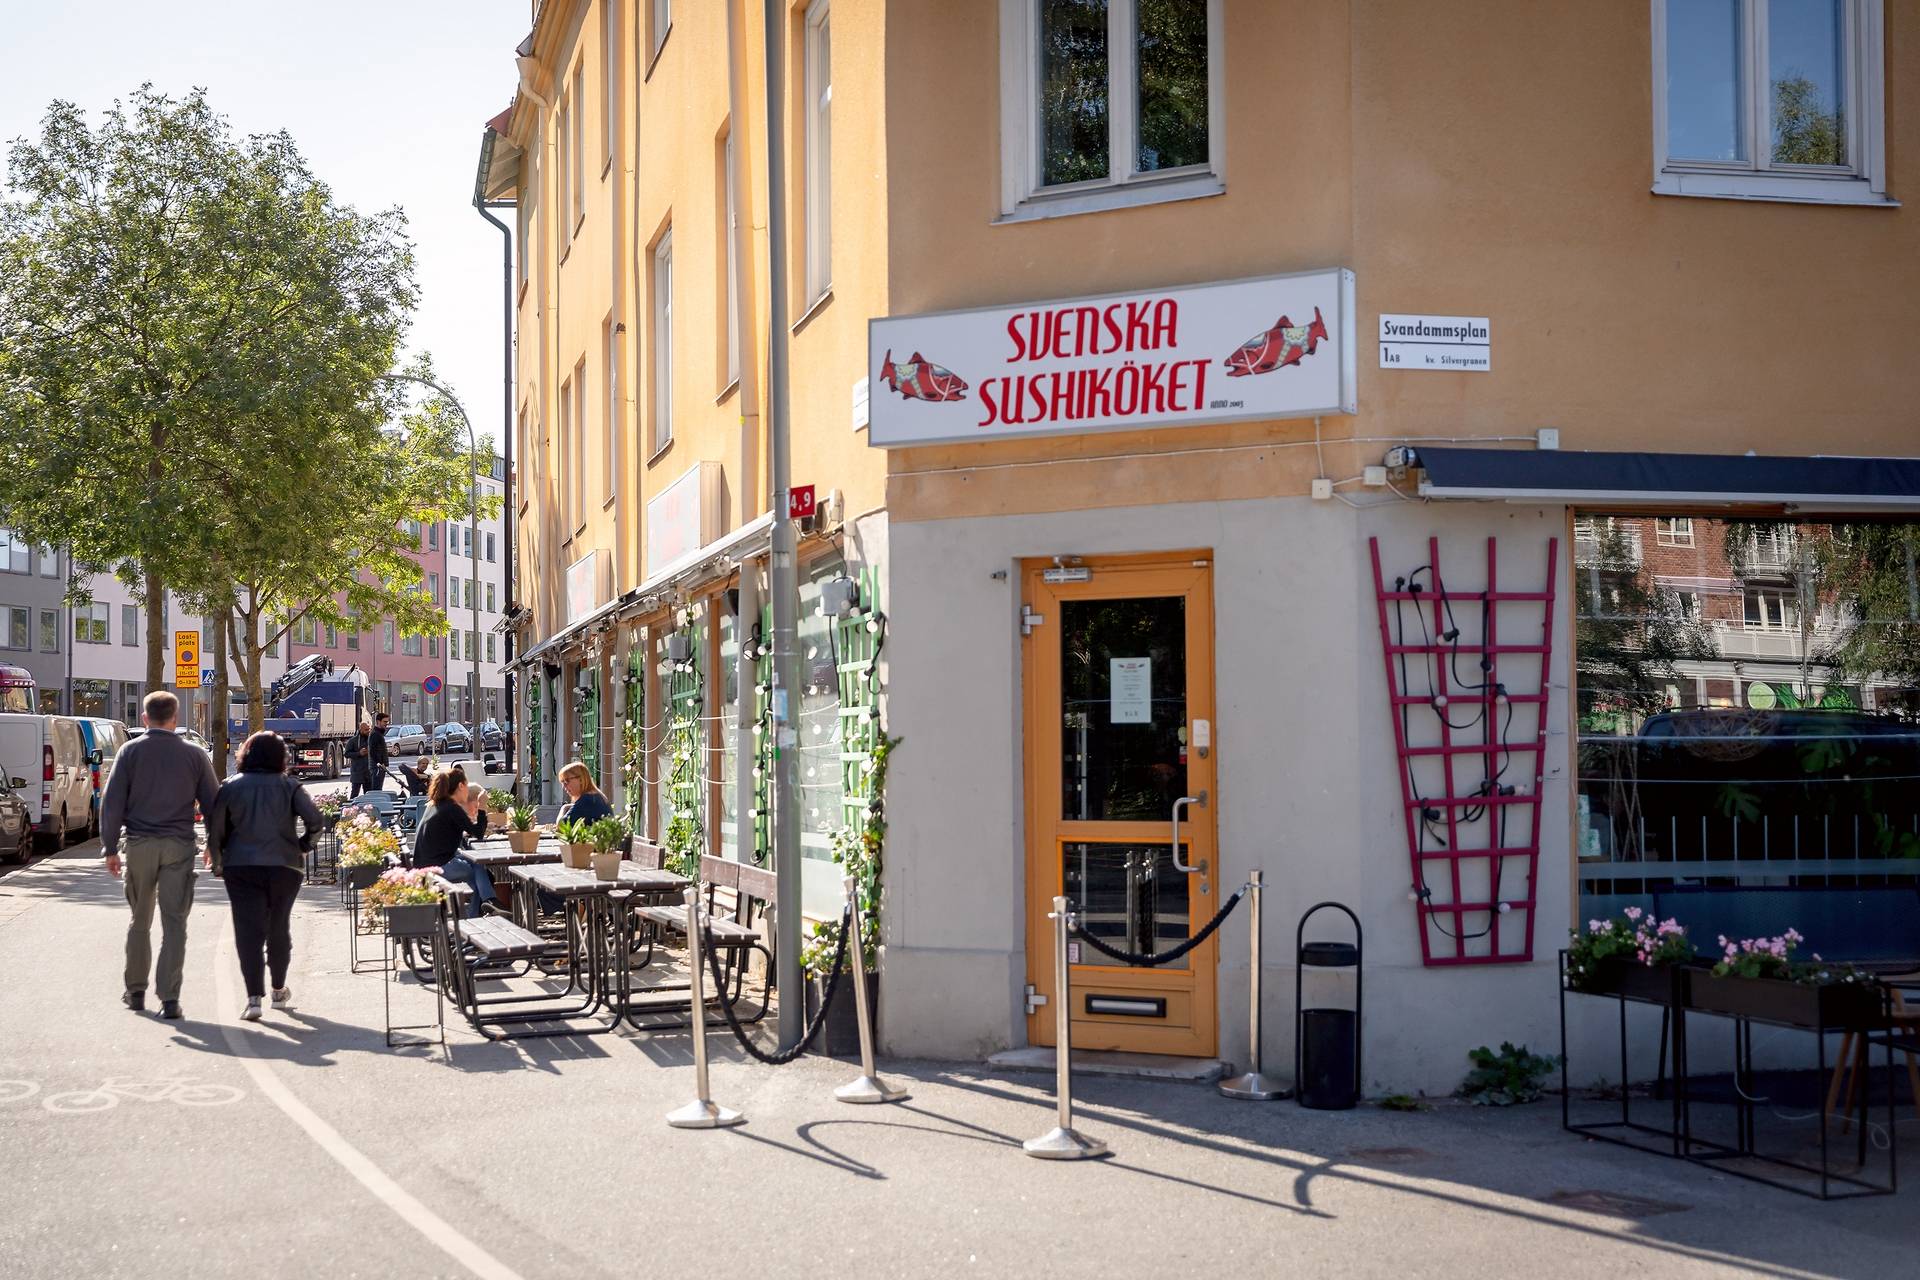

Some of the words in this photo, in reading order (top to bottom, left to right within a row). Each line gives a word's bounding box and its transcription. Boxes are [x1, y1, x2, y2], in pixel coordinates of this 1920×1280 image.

[1006, 298, 1178, 363] SVENSKA
[1384, 320, 1487, 341] Svandammsplan
[978, 359, 1213, 428] SUSHIKÖKET
[1210, 400, 1228, 408] ANNO
